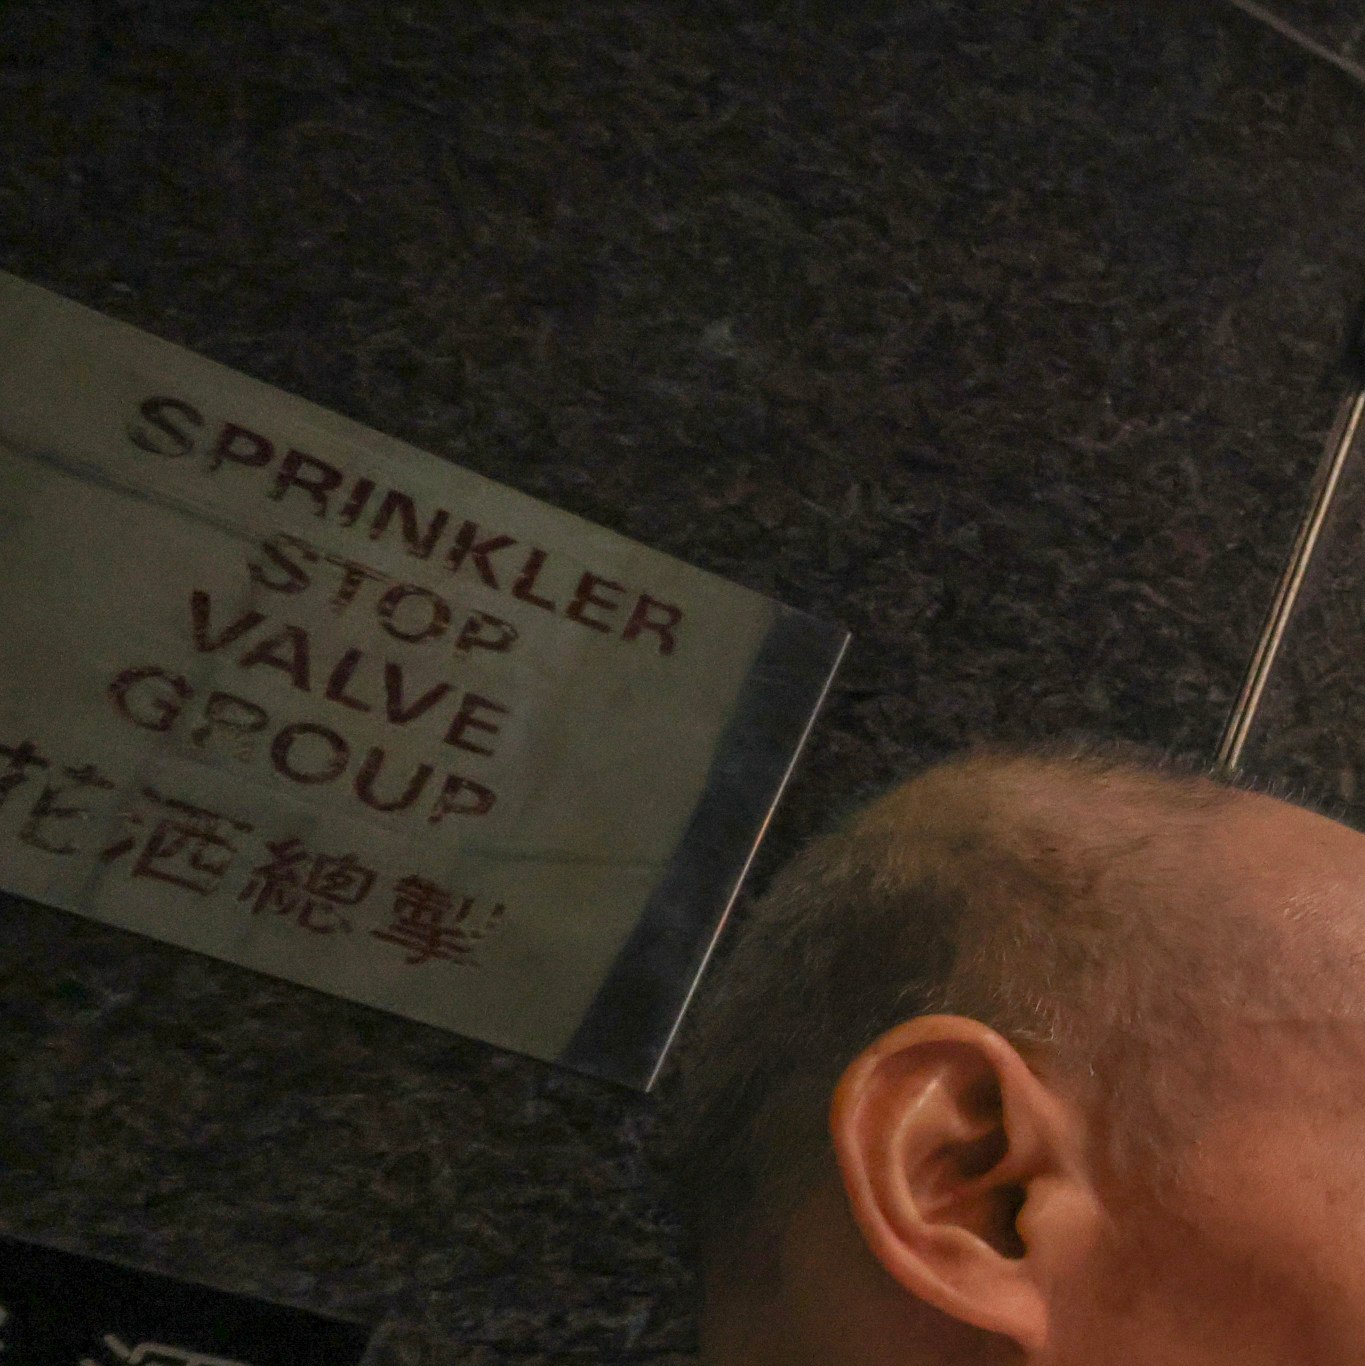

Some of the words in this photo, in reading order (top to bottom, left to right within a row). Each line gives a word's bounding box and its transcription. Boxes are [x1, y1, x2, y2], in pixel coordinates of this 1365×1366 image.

[125, 394, 691, 658] SPRINKLER
[245, 530, 521, 662] STOP
[187, 589, 511, 758] VALVE
